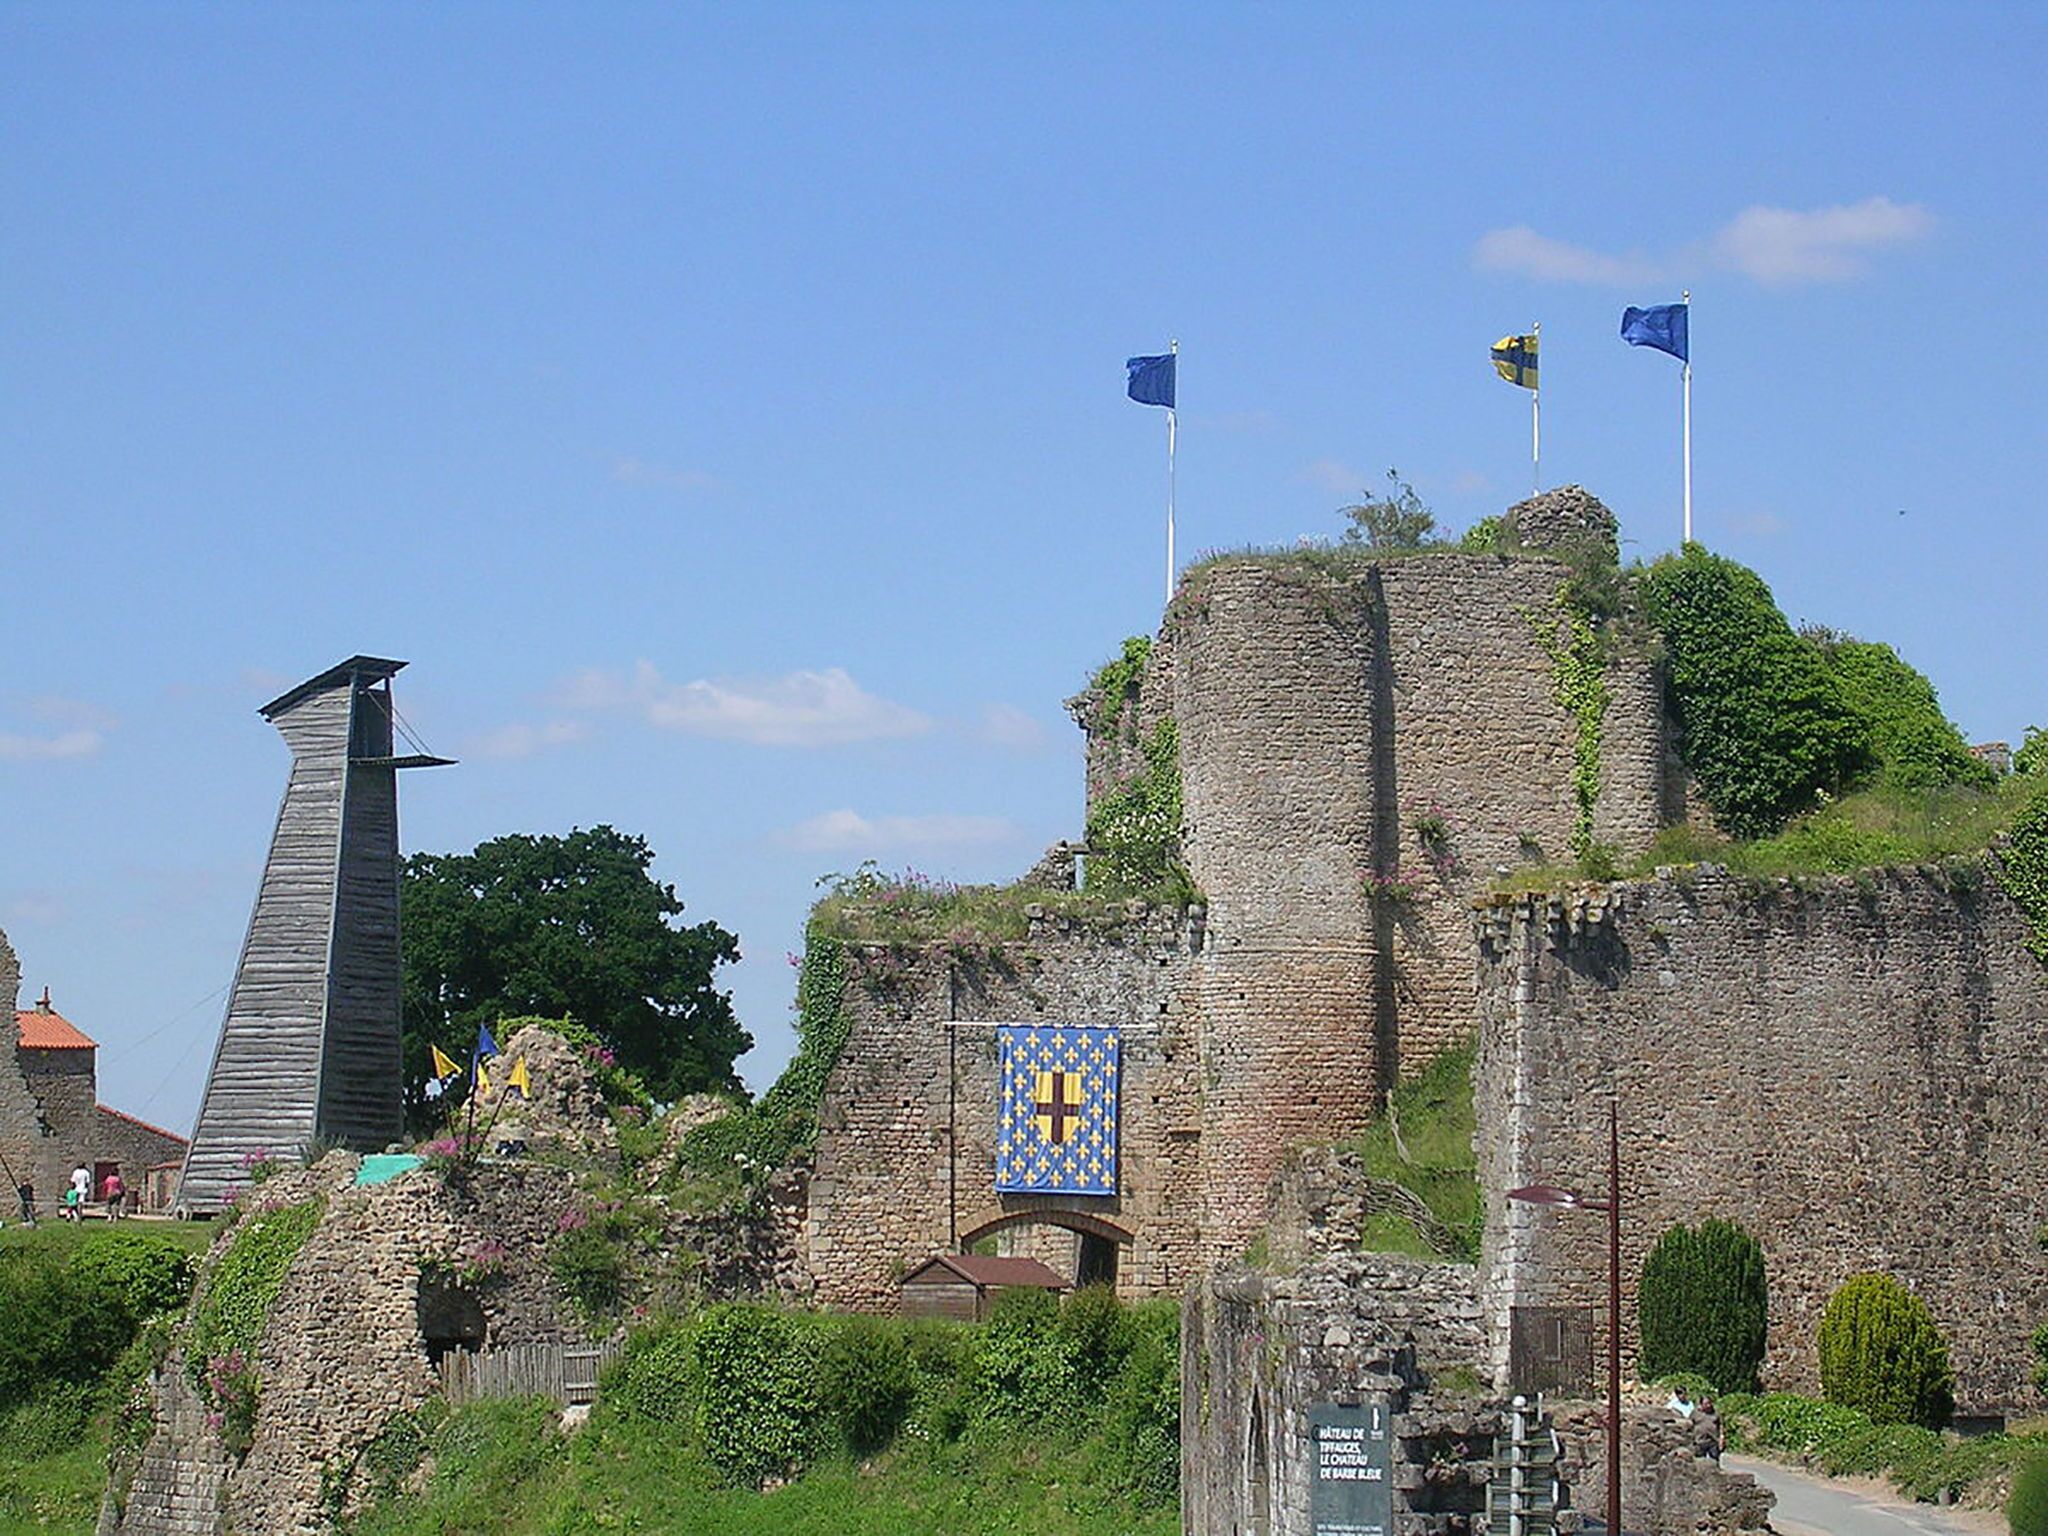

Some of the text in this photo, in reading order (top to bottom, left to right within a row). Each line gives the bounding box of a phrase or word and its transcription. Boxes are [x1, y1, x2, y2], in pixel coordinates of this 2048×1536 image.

[1353, 1428, 1364, 1440] DE
[1320, 1454, 1329, 1465] LE
[1320, 1467, 1382, 1480] DE BARBE BLEUE
